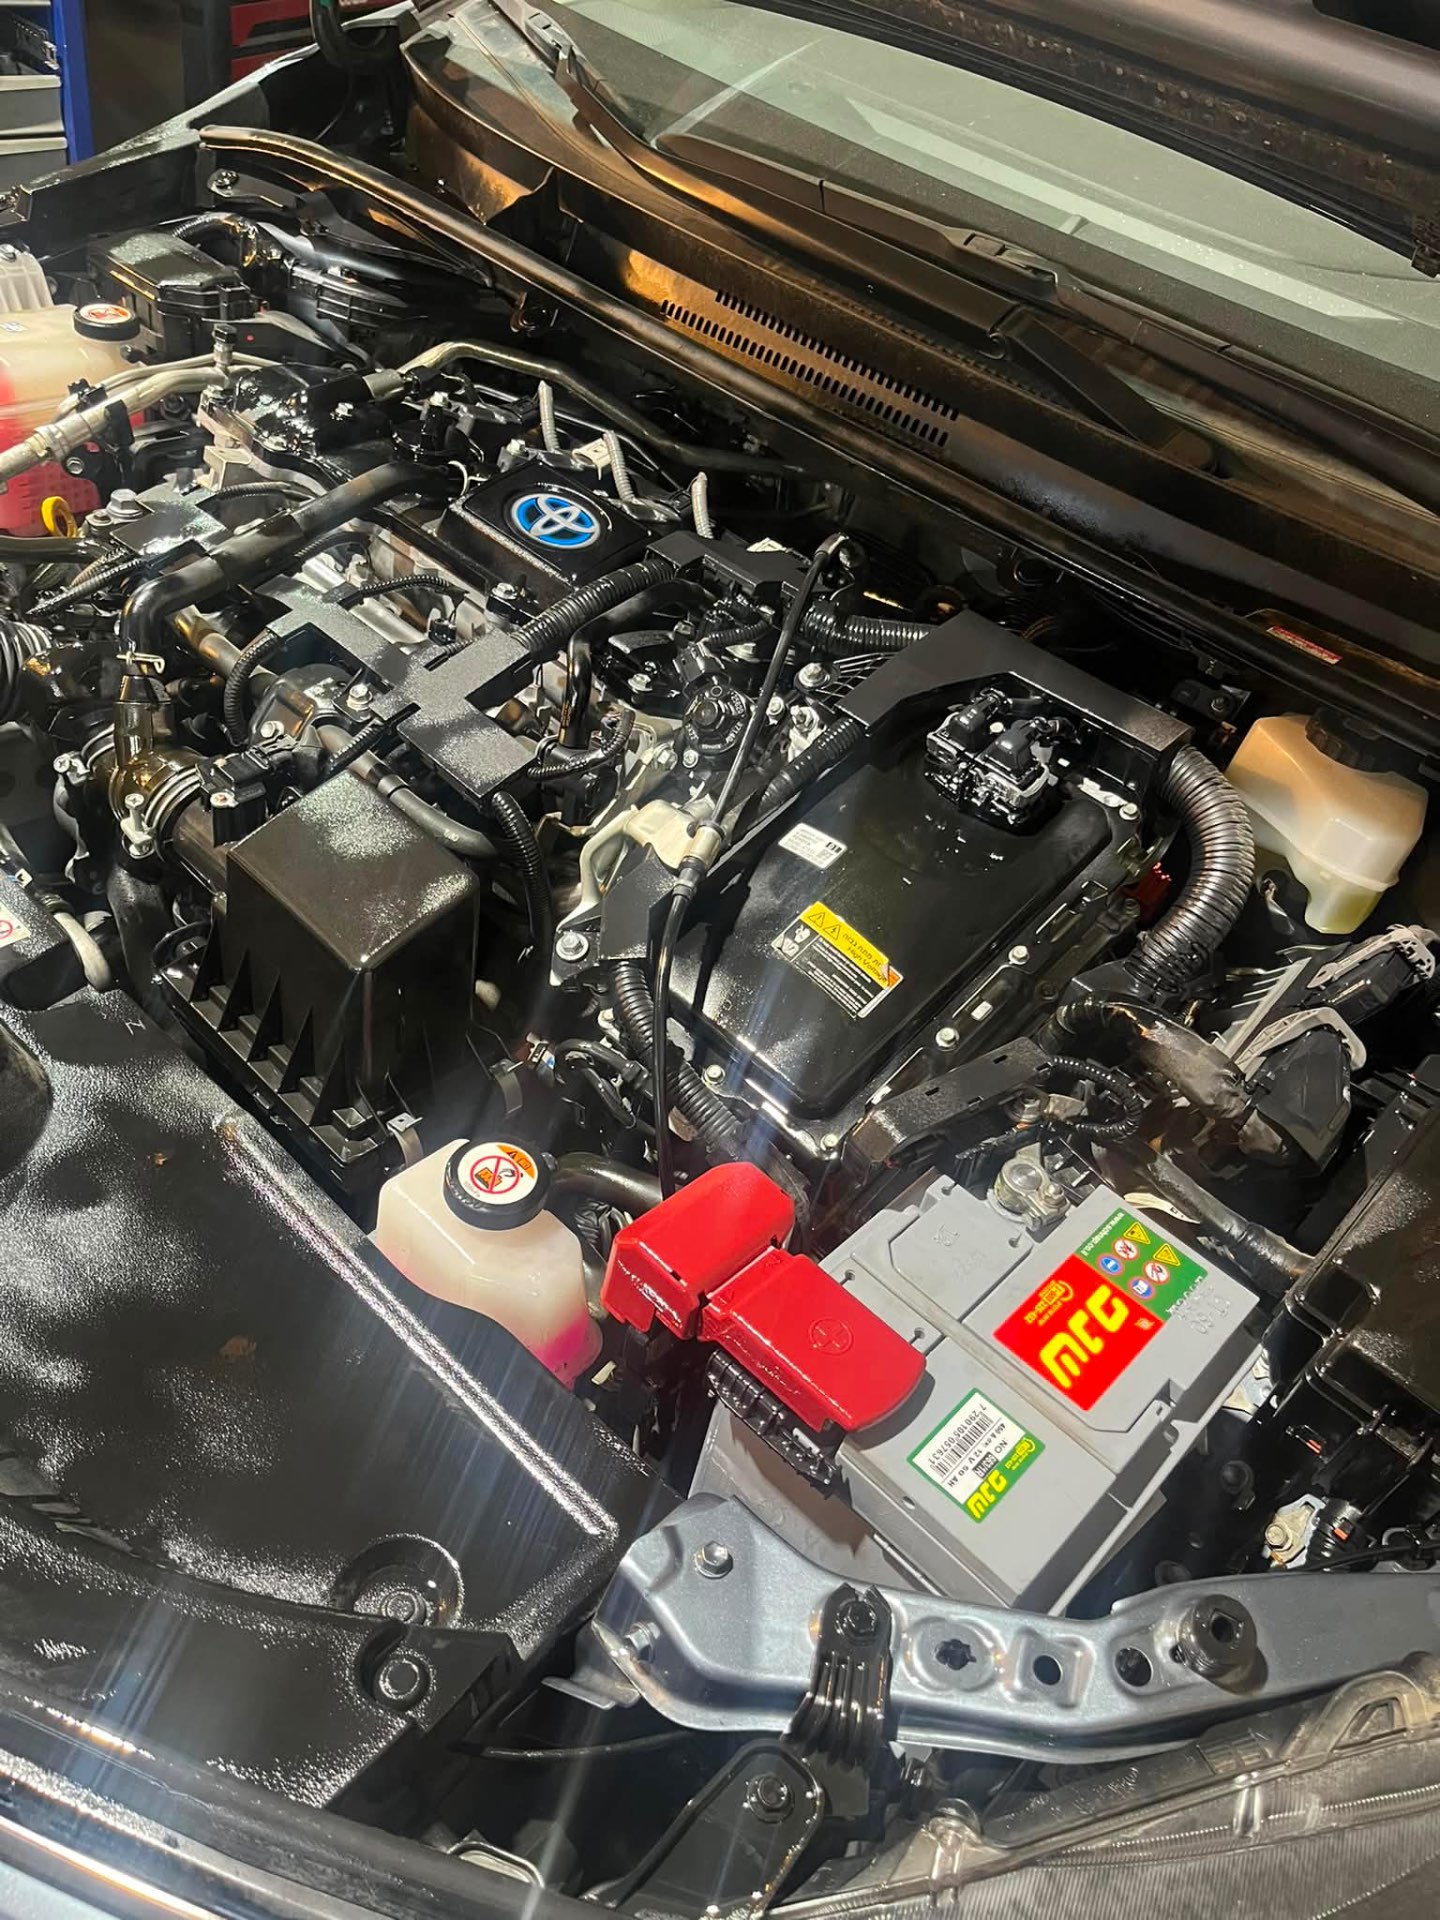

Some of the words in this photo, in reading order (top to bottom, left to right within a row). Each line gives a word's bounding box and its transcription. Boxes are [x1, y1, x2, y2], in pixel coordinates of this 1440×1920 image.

[848, 947, 862, 962] High
[1040, 1284, 1130, 1389] שנפ
[953, 1409, 980, 1438] 290105
[928, 1436, 956, 1464] 057631
[974, 1448, 982, 1457] 12
[994, 1440, 1008, 1454] NO
[968, 1456, 976, 1464] V
[948, 1475, 958, 1487] AH
[966, 1469, 1008, 1520] שנפ
